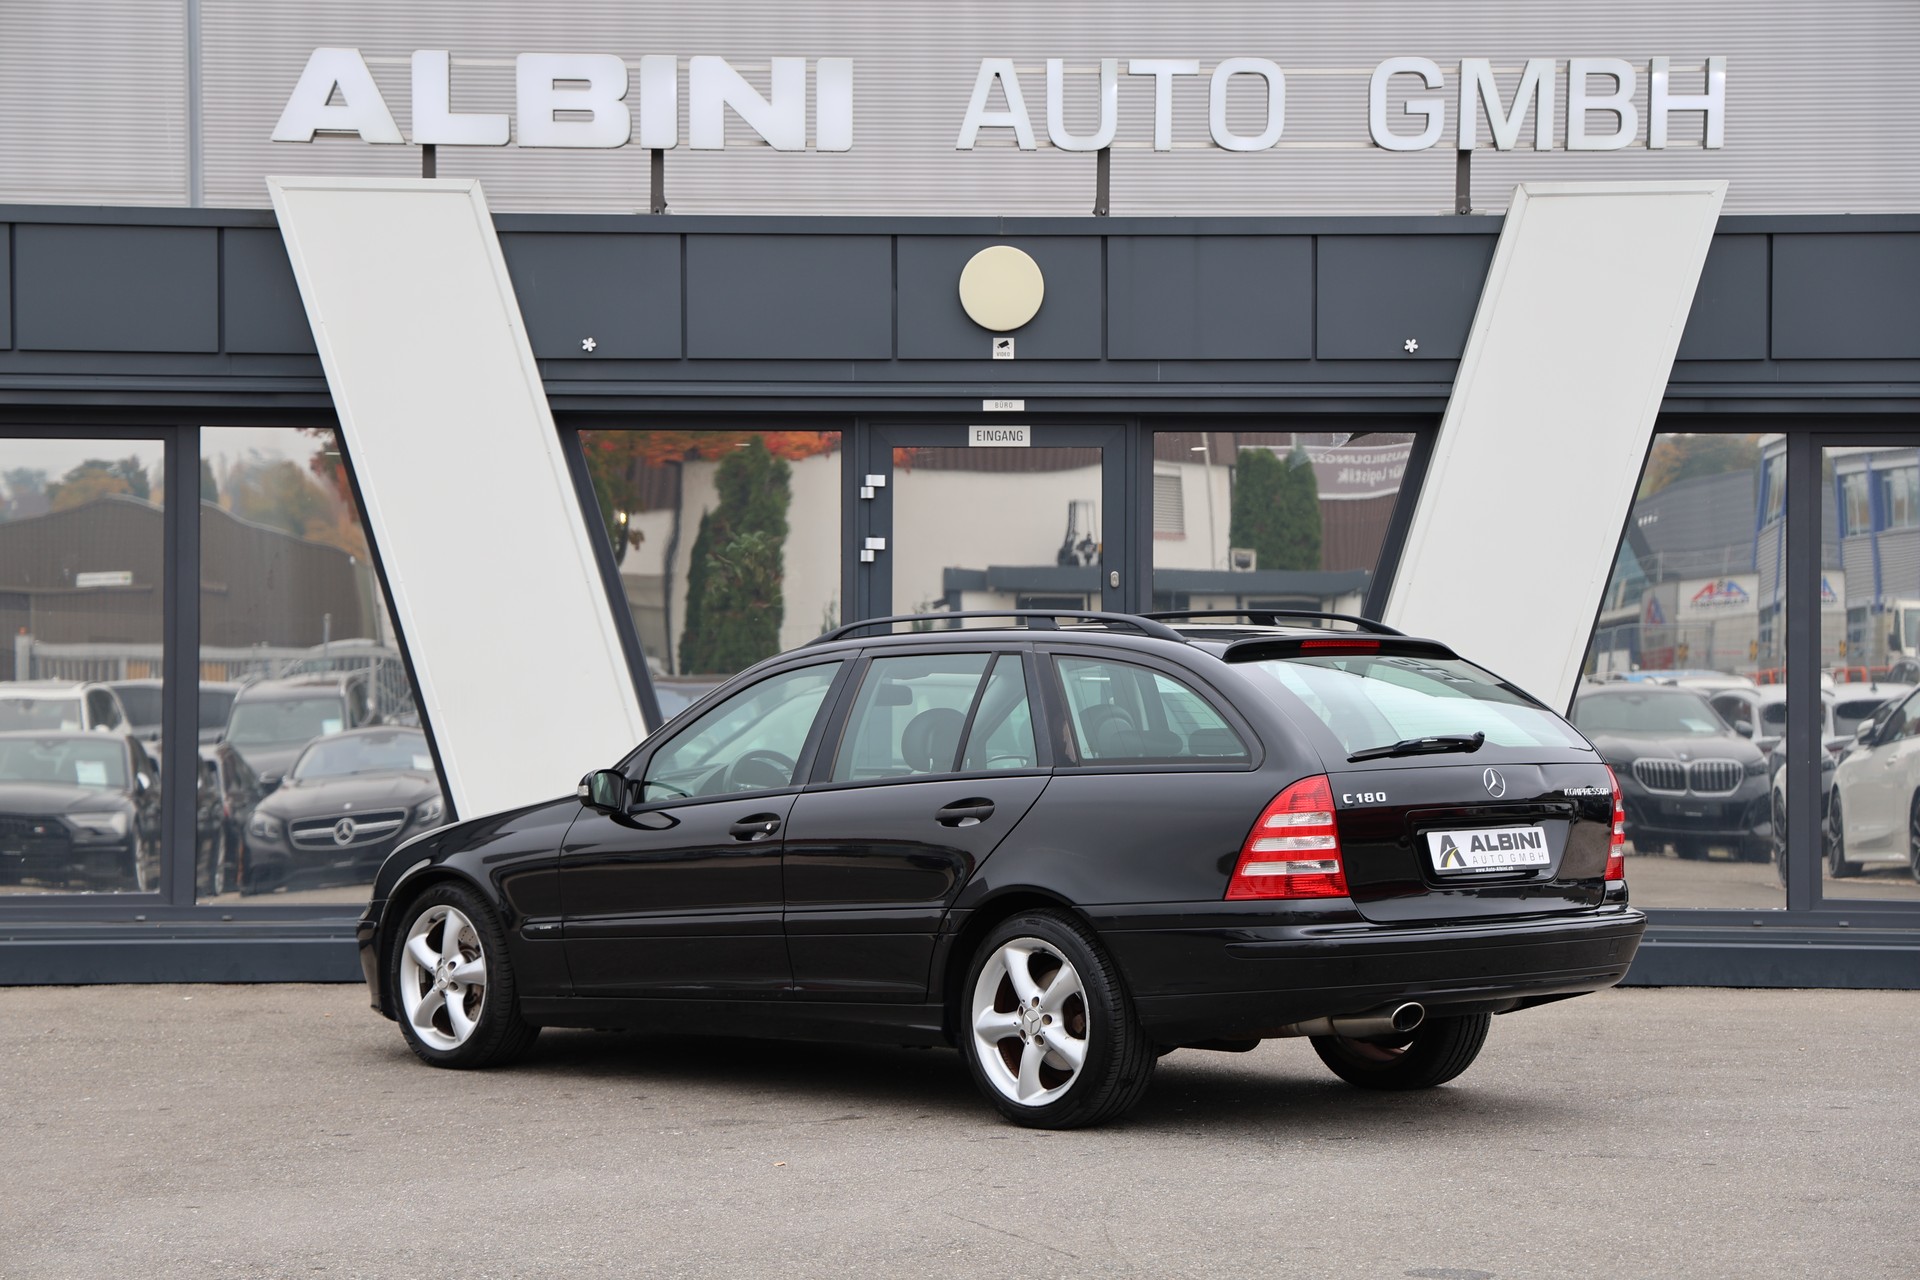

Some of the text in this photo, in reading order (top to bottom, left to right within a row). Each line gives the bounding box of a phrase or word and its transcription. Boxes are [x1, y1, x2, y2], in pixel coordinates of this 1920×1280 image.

[272, 47, 1727, 152] ALBINI AUTO GMBH
[994, 401, 1014, 409] BÜRO
[976, 430, 1024, 442] EINGANG
[1342, 791, 1387, 804] C 180
[1563, 787, 1610, 796] KOMPRESSOR
[1470, 831, 1542, 852] ALBINI
[1472, 851, 1545, 865] AUTO GMBH
